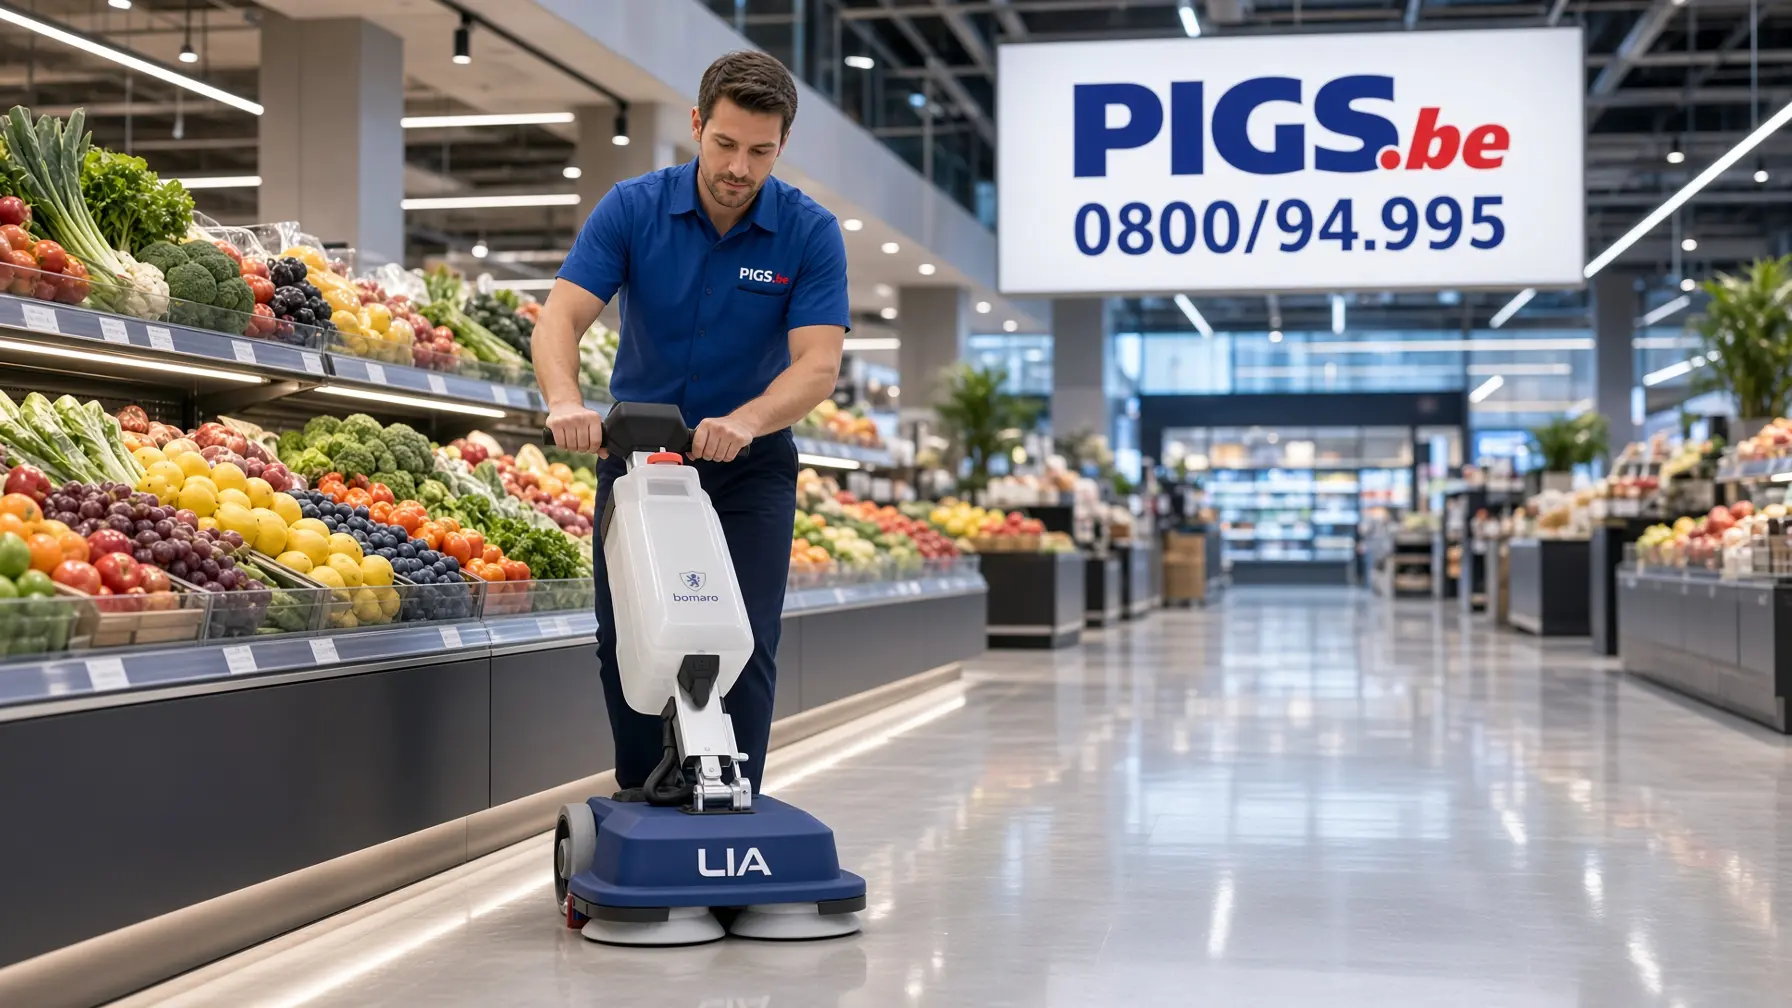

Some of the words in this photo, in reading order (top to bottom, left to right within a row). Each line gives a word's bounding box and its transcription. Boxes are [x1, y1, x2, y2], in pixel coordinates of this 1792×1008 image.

[1073, 74, 1510, 178] PIGS.be
[1074, 195, 1505, 257] 0800/94.995
[739, 267, 789, 284] PIGS.be
[673, 593, 719, 602] bomaro
[697, 847, 772, 877] LIA
